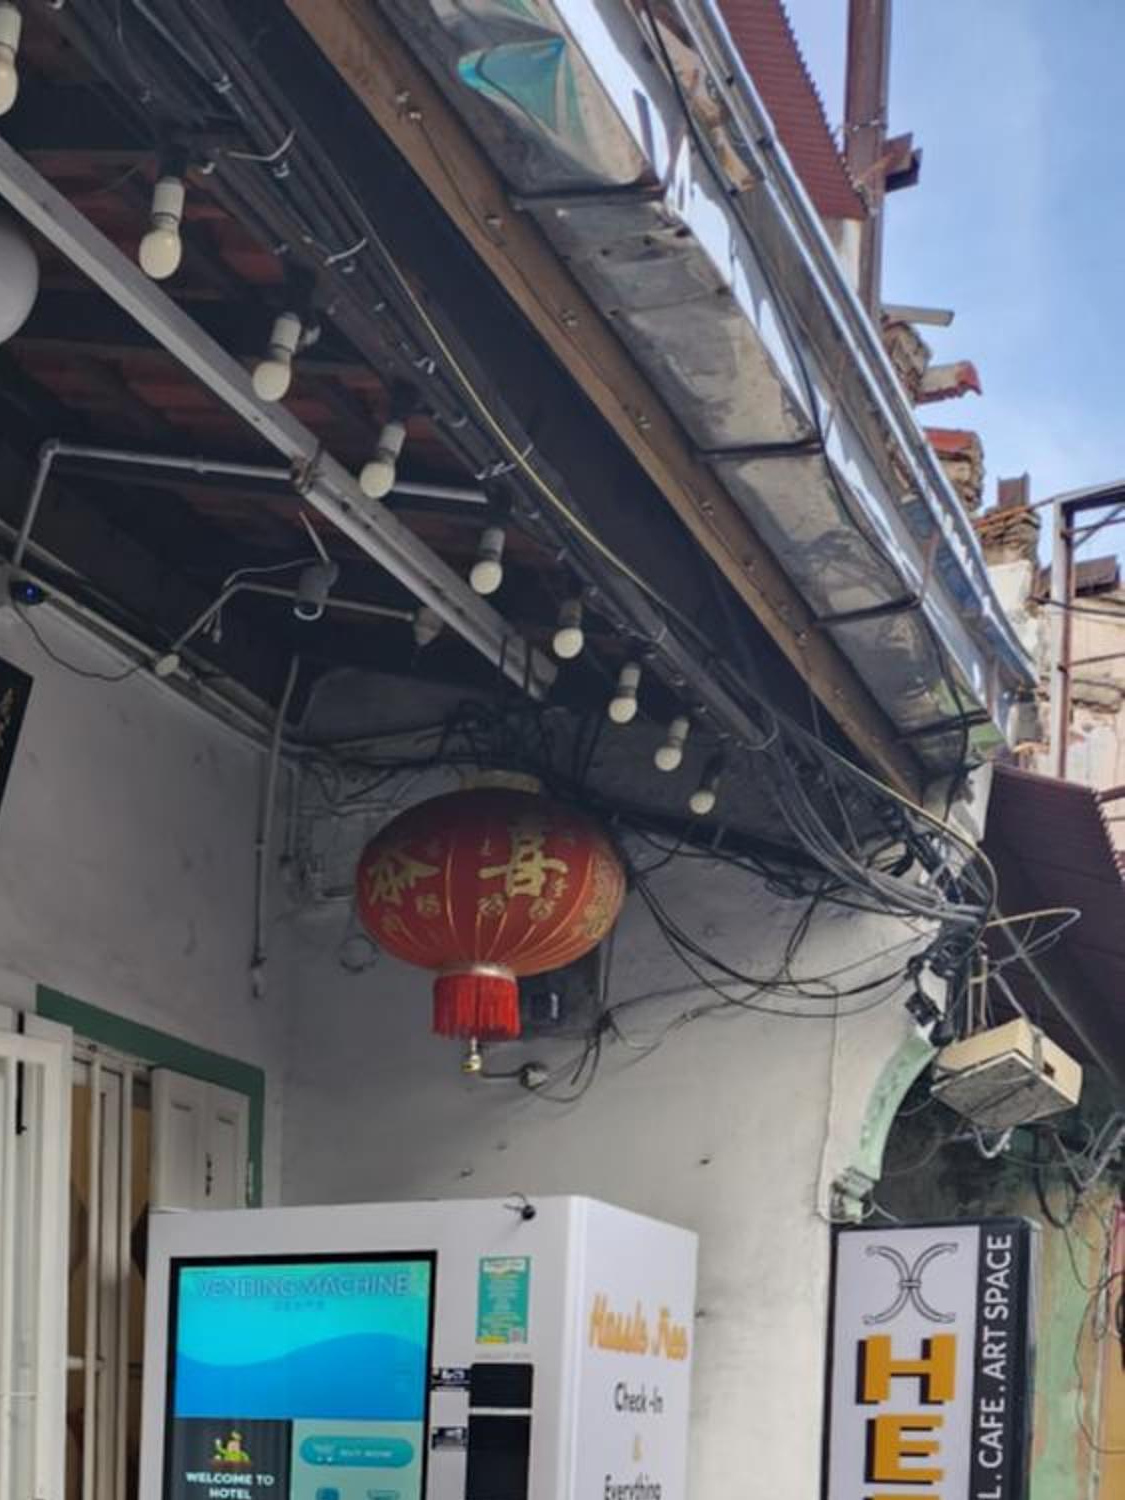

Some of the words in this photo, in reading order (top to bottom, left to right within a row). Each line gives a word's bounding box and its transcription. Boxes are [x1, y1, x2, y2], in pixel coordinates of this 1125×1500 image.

[299, 1271, 412, 1297] MACHINE
[983, 1234, 1012, 1320] SPACE
[981, 1325, 1008, 1380] ART
[185, 1471, 253, 1486] WELCOME
[256, 1474, 274, 1486] TO
[209, 1487, 251, 1500] HOTEL
